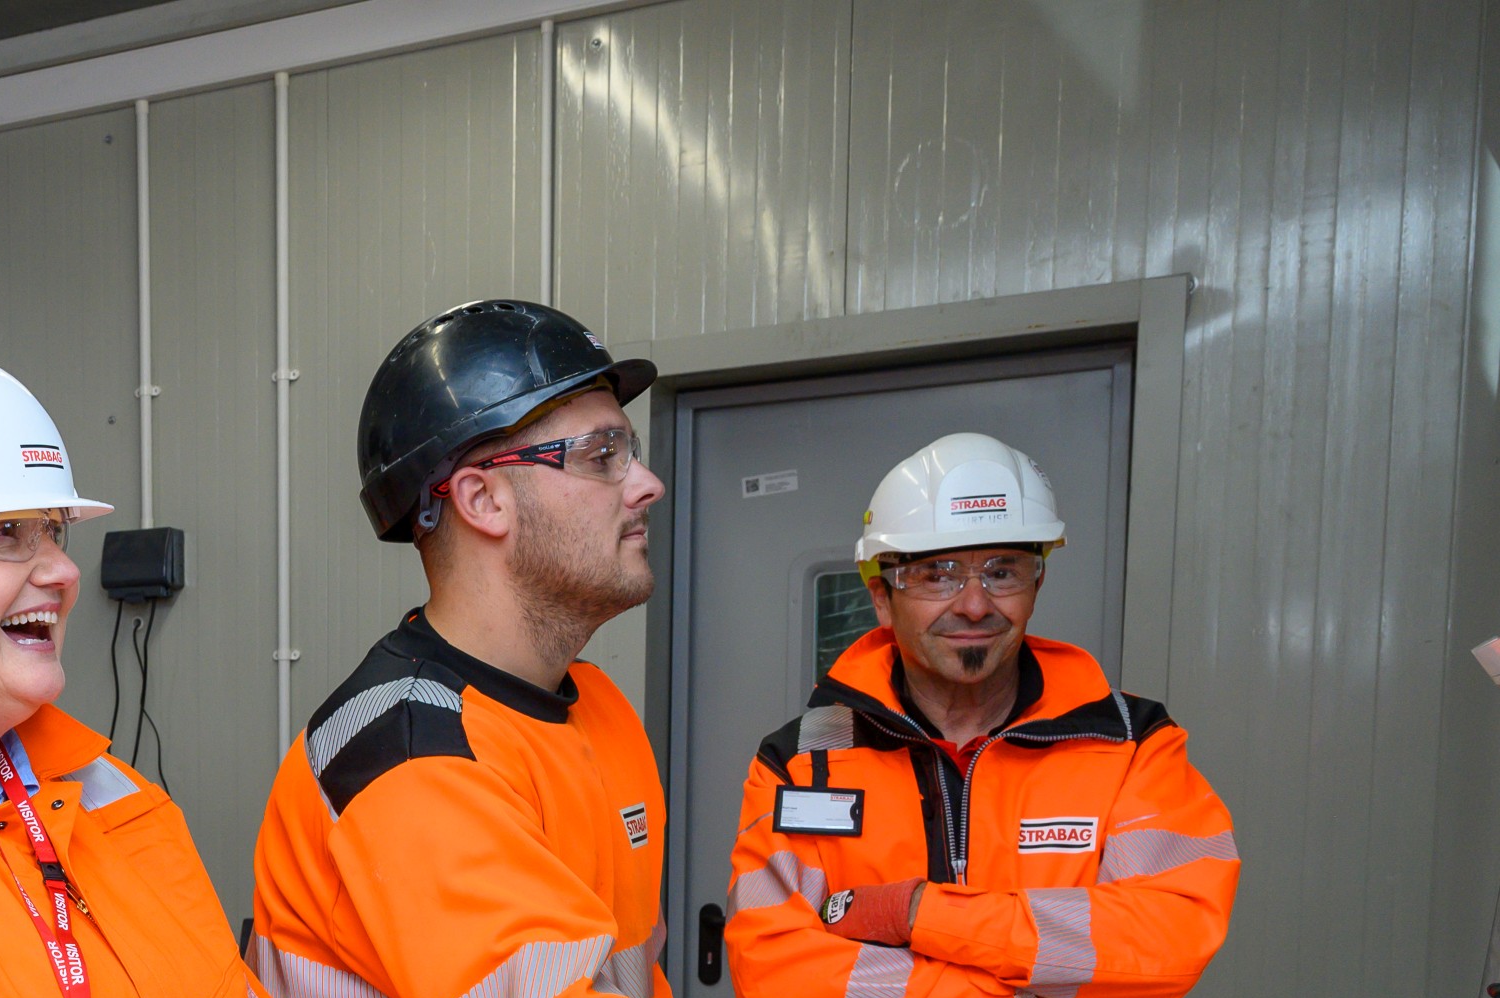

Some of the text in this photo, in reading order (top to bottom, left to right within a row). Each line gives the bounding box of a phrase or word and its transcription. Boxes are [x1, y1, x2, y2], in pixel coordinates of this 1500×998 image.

[21, 450, 63, 464] STRABAG
[950, 498, 1007, 511] STRABAG
[16, 799, 45, 843] VISITOR
[1018, 828, 1093, 843] STRABAG
[54, 892, 69, 932] VISITOR
[65, 943, 85, 986] VISITOR
